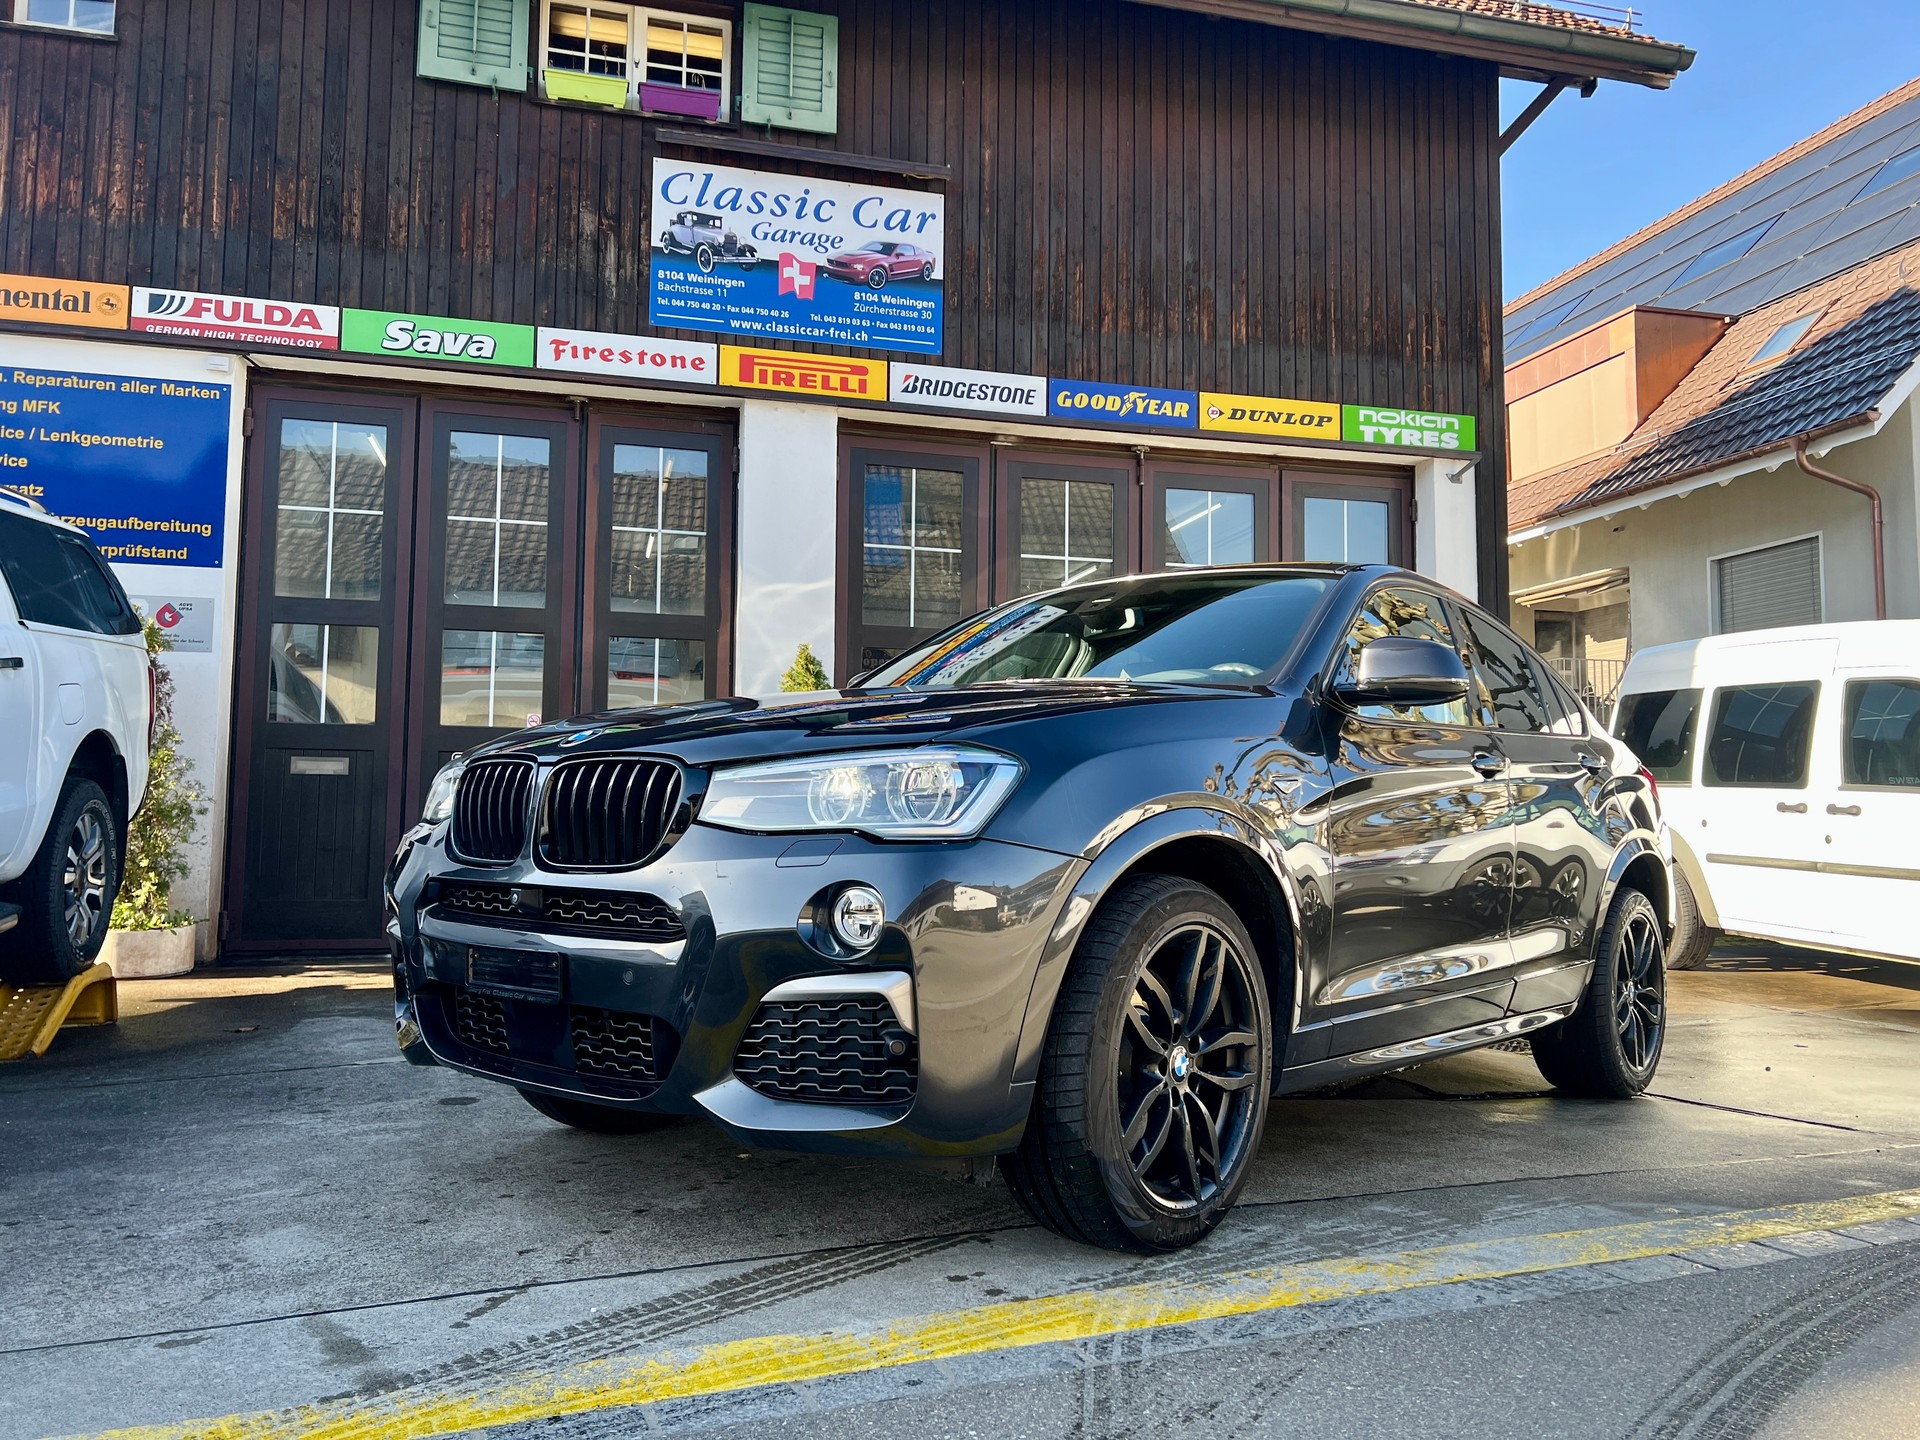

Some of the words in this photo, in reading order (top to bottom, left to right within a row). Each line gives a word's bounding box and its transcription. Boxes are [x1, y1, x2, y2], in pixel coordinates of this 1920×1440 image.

[660, 172, 836, 222] Classic
[852, 197, 937, 234] Car
[751, 221, 844, 254] Garage
[657, 270, 684, 280] 8104
[686, 273, 745, 288] Weiningen
[657, 281, 714, 296] Bachstrasse
[716, 288, 727, 297] 11
[657, 297, 670, 305] Tel.
[671, 299, 685, 307] 044
[701, 302, 711, 310] 40
[712, 303, 721, 311] 20
[727, 305, 740, 313] Fax
[741, 306, 754, 314] 044
[756, 308, 769, 316] 750
[770, 309, 779, 317] 40
[854, 291, 879, 302] 8104
[881, 294, 935, 309] Weiningen
[177, 297, 323, 330] FULDA
[853, 303, 919, 318] Zürcherstrasse
[921, 311, 932, 320] 30
[730, 319, 868, 341] www.classiccar-frei.ch
[810, 314, 823, 322] Tel.
[824, 315, 837, 323] 043
[838, 317, 851, 325] 819
[851, 318, 861, 326] 03
[862, 319, 871, 327] 63
[876, 321, 889, 329] Fax
[889, 322, 902, 330] 043
[903, 324, 916, 332] 819
[916, 325, 925, 333] 03
[926, 326, 935, 334] 64
[145, 324, 200, 338] GERMAN
[203, 327, 236, 342] HIGH
[238, 332, 323, 349] TECHNOLOGY
[381, 319, 497, 360] Sava
[549, 338, 706, 371] Firestone
[739, 353, 869, 394] PIRELLI
[13, 370, 116, 391] Reparaturen
[120, 381, 157, 395] aller
[161, 383, 221, 400] Marken
[900, 374, 1037, 406] BRIDGESTONE
[22, 399, 61, 415] MFK
[1227, 407, 1333, 428] DUNLOP
[1359, 408, 1460, 430] nokian
[39, 428, 164, 450] Lenkgeometrie
[1359, 425, 1460, 449] TYRES
